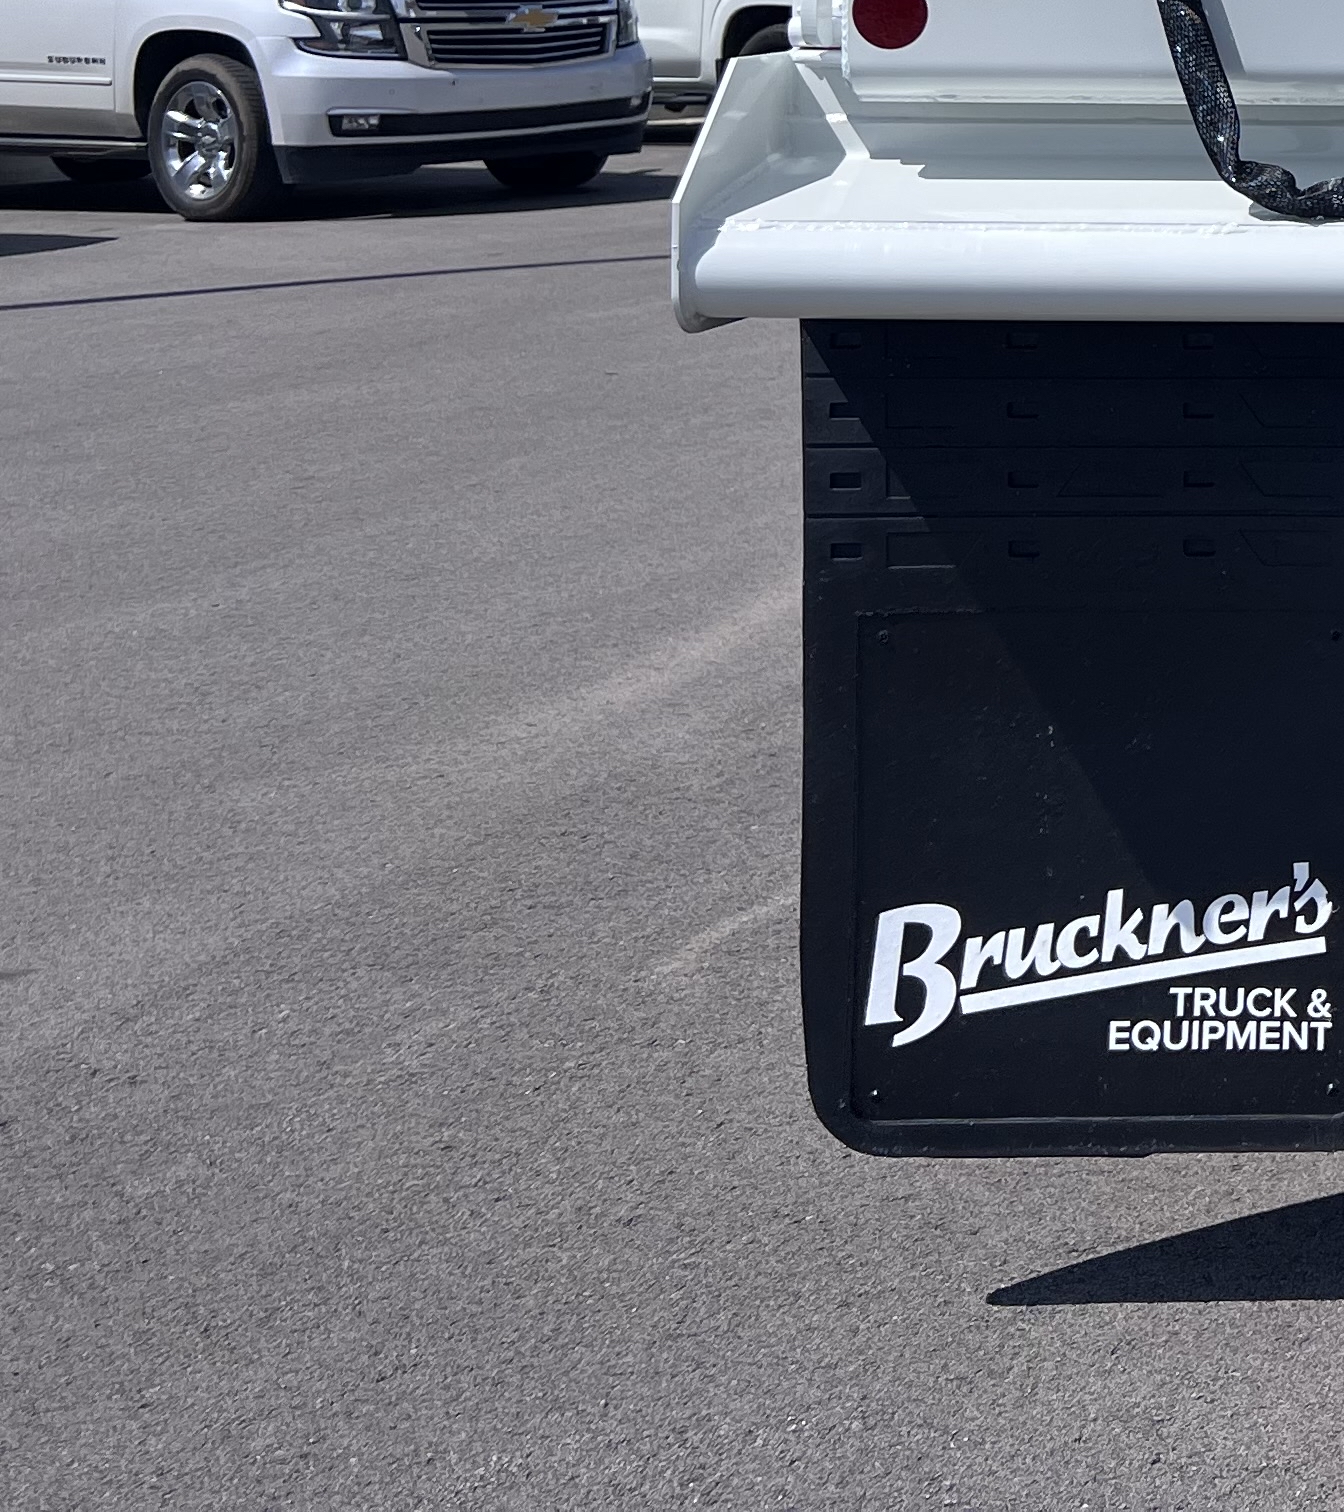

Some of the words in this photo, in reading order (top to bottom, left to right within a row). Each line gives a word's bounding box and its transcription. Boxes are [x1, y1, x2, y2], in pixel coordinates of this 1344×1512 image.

[864, 861, 1333, 1048] Bruckner's
[1169, 987, 1298, 1018] TRUCK
[1305, 988, 1332, 1018] &
[1108, 1020, 1333, 1052] EQUIPMENT
